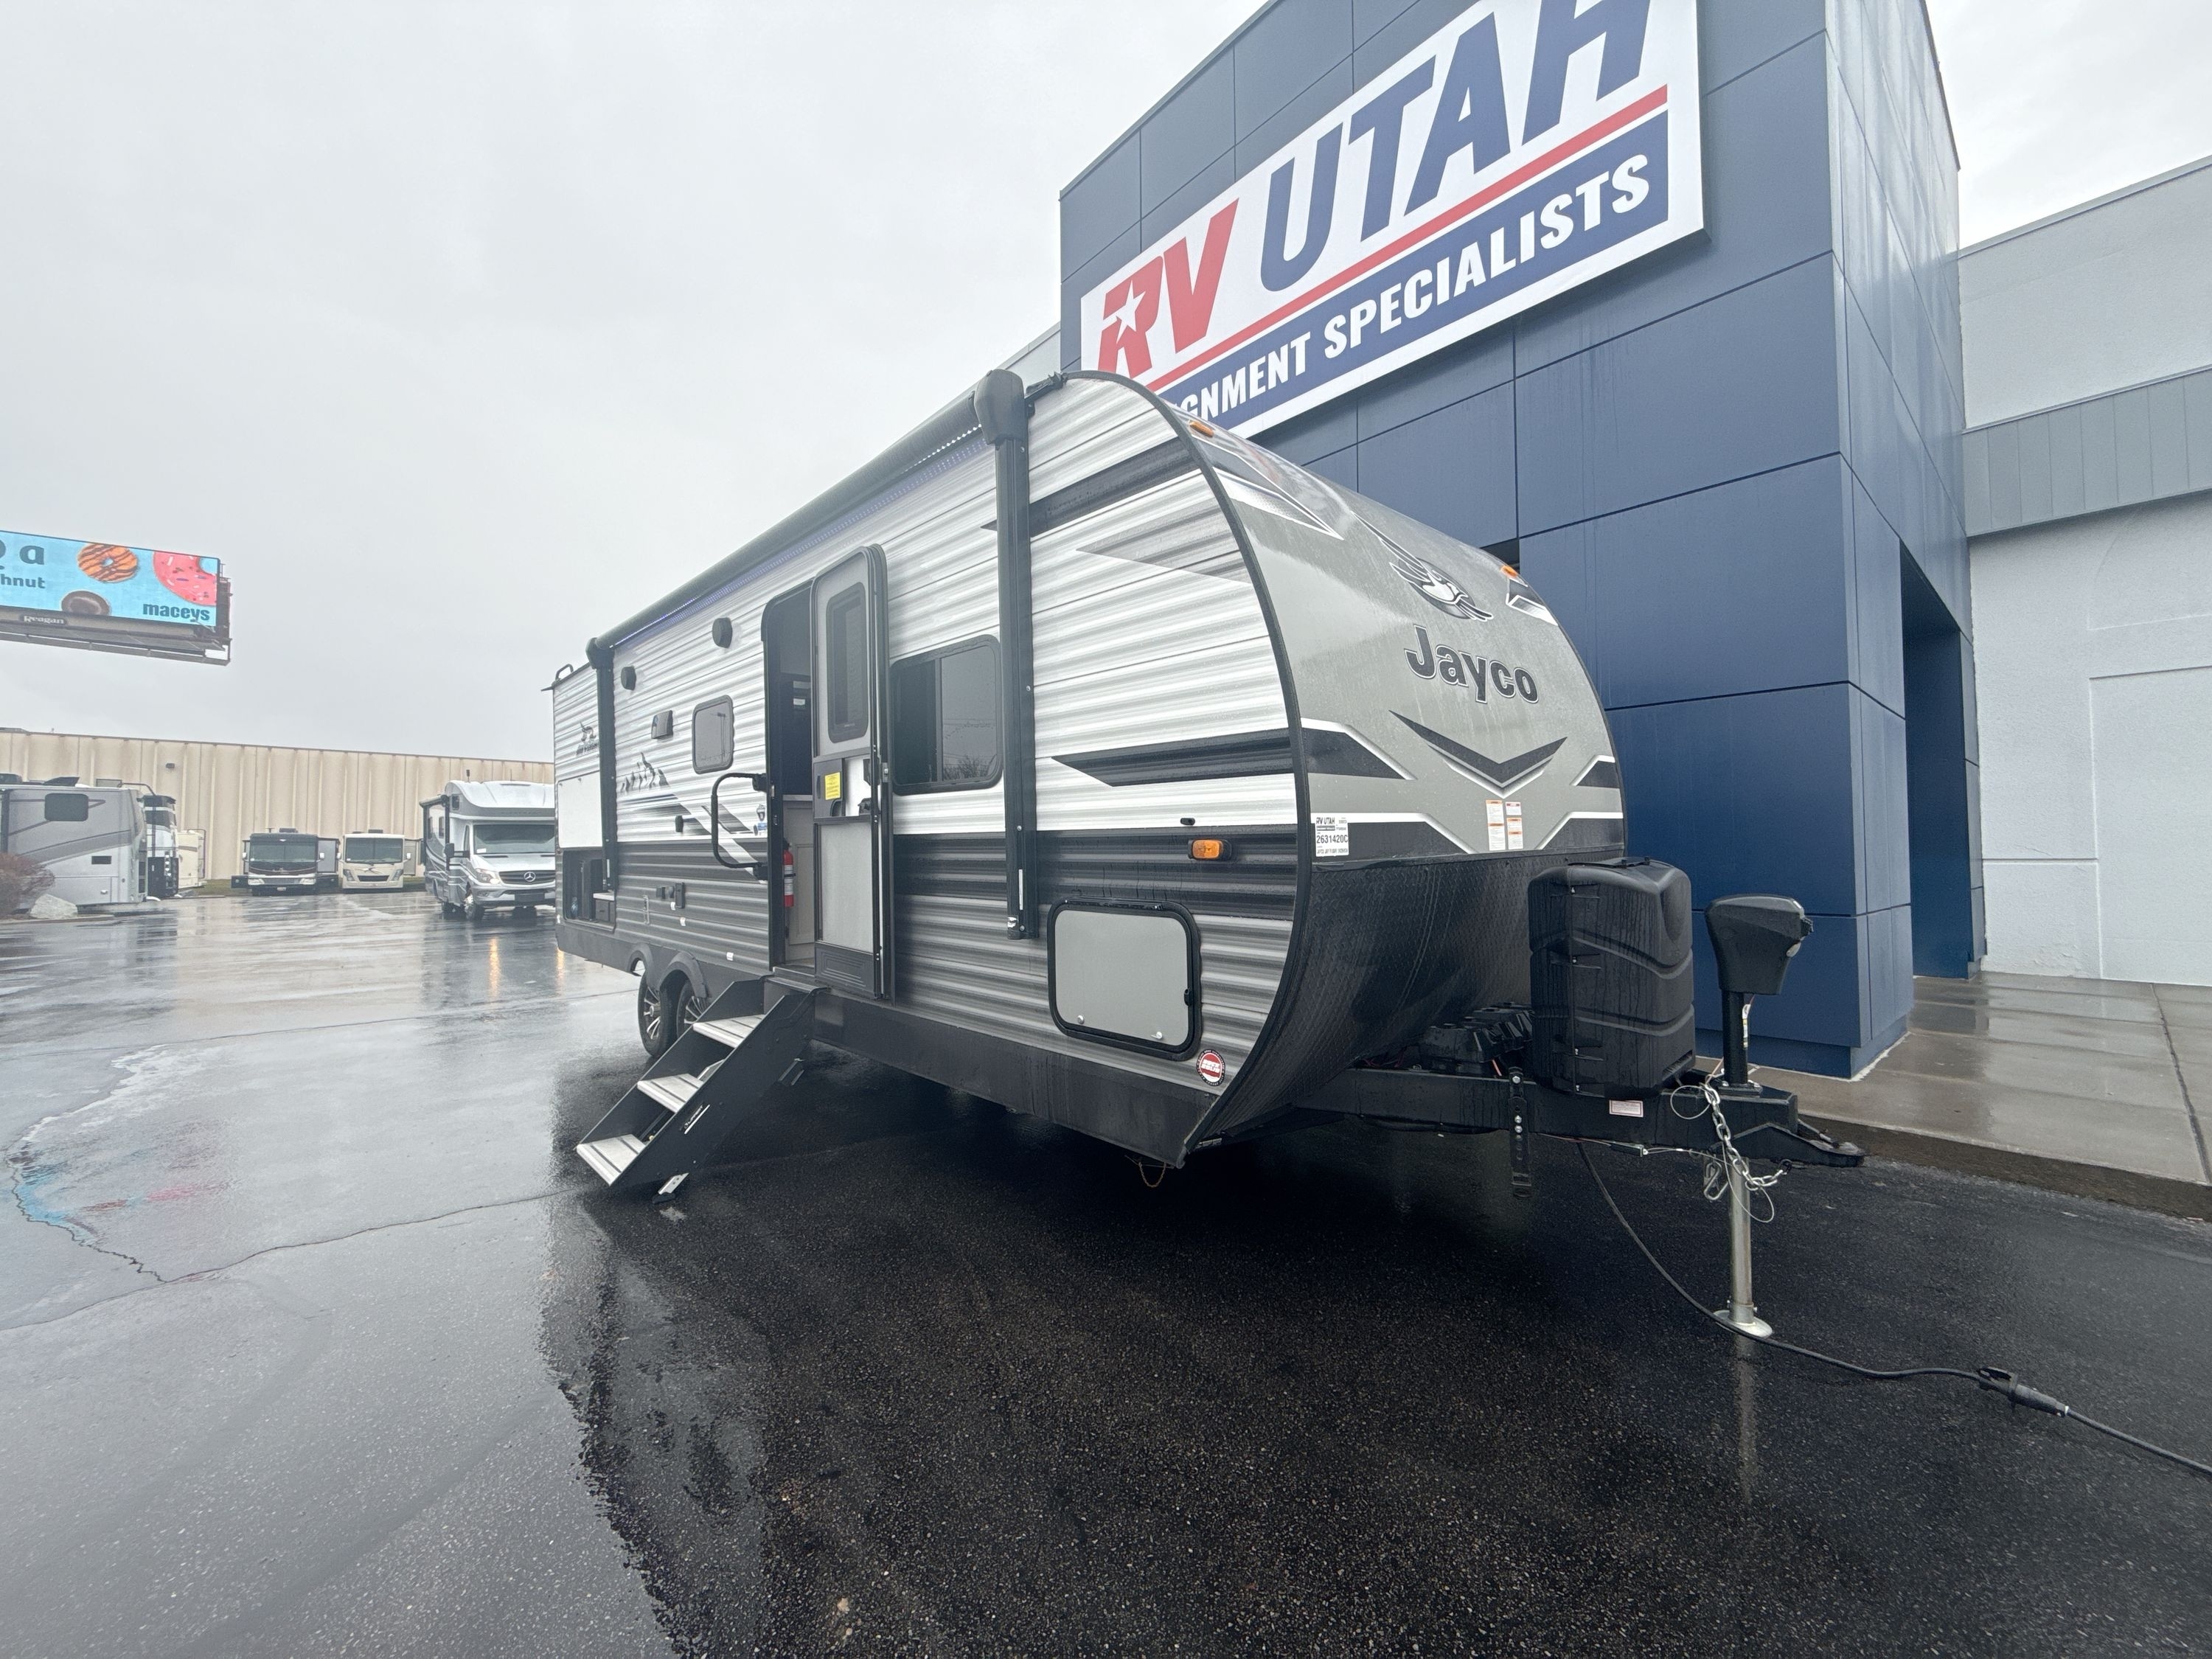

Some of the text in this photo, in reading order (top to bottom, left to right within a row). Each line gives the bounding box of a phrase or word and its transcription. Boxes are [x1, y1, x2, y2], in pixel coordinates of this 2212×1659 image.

[1097, 0, 1651, 379] RV UTAH
[1324, 153, 1650, 357] SPECIALISTS
[19, 545, 44, 565] a
[24, 616, 64, 624] Reagan
[142, 603, 210, 622] maceys
[1403, 623, 1540, 704] Jayco
[1316, 835, 1349, 844] 2631420C
